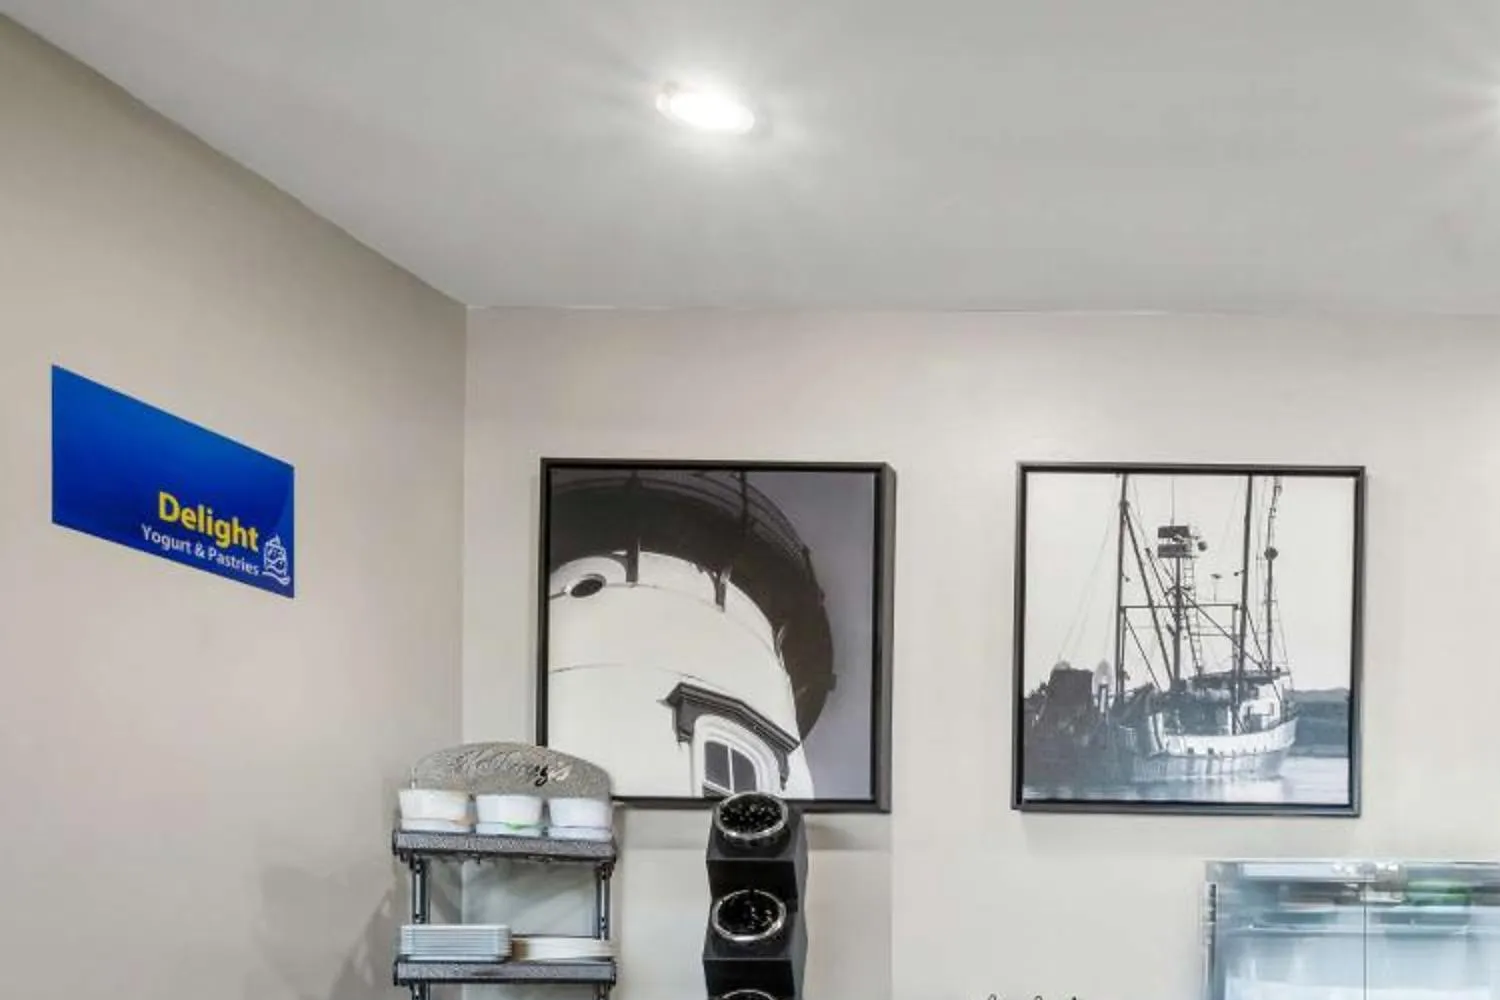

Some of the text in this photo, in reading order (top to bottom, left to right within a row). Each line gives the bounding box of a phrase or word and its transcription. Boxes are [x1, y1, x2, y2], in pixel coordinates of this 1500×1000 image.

[141, 523, 259, 576] Yogurt & Pastries
[159, 491, 259, 553] Delight
